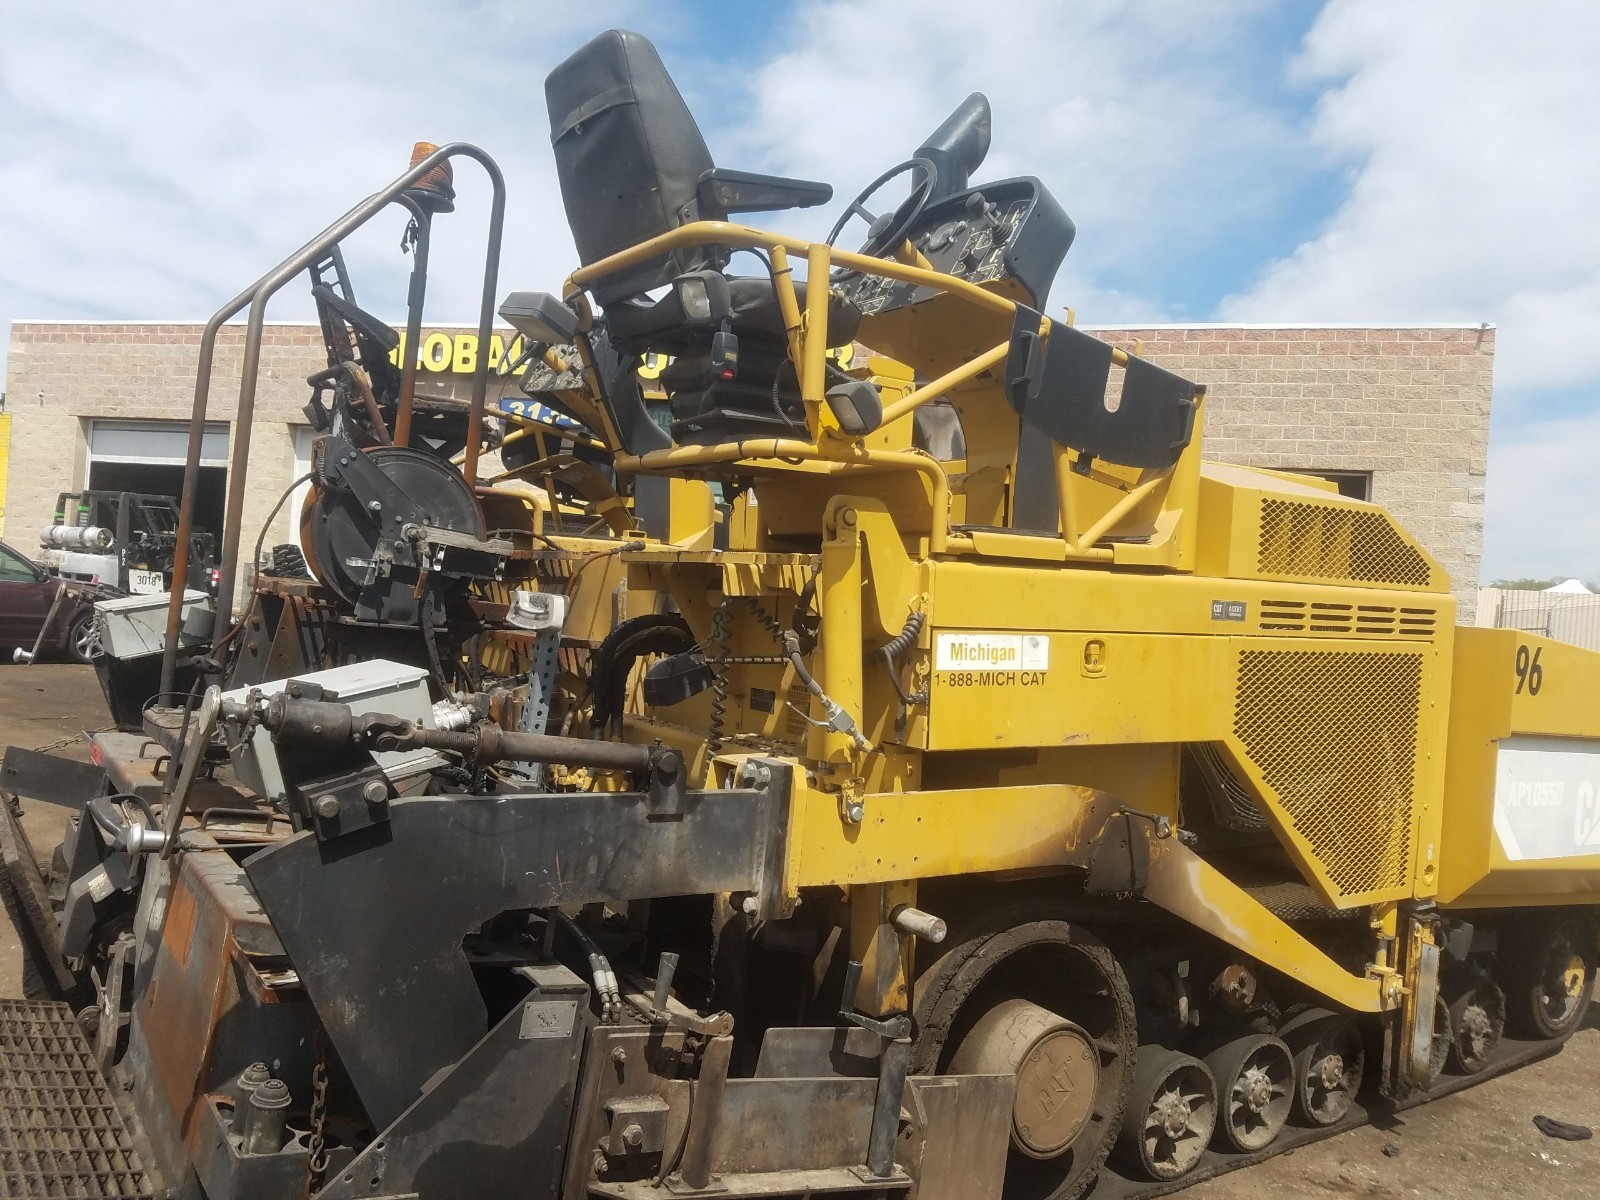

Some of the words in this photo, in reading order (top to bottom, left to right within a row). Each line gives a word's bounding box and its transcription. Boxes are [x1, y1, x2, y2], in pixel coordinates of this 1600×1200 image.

[137, 575, 157, 586] 3018
[950, 643, 1015, 665] Michigan
[1020, 671, 1047, 686] CAT
[1515, 644, 1543, 696] 96
[1508, 781, 1565, 807] AP1055D
